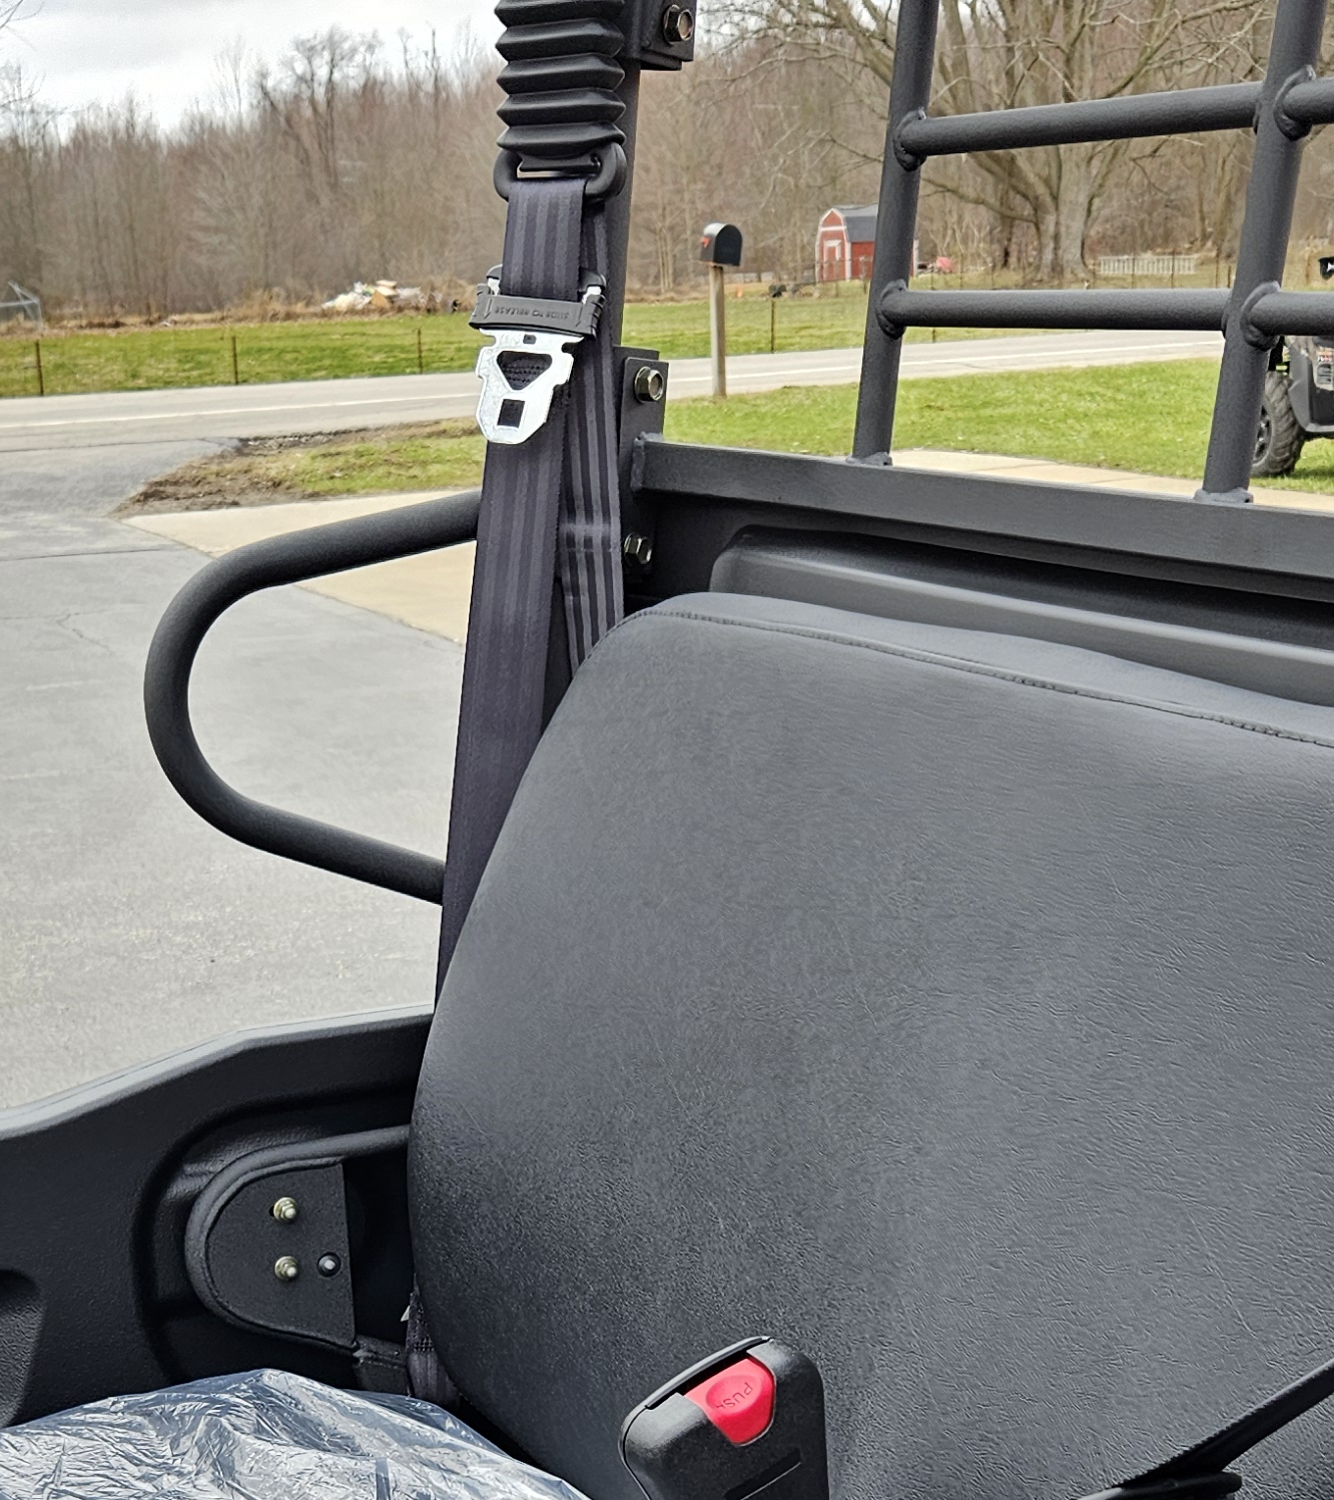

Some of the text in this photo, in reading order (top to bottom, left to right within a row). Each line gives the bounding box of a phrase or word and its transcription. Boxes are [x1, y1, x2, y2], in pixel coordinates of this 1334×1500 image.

[495, 306, 530, 317] RELEASE
[532, 309, 544, 319] TO
[715, 1381, 753, 1410] PUSH
